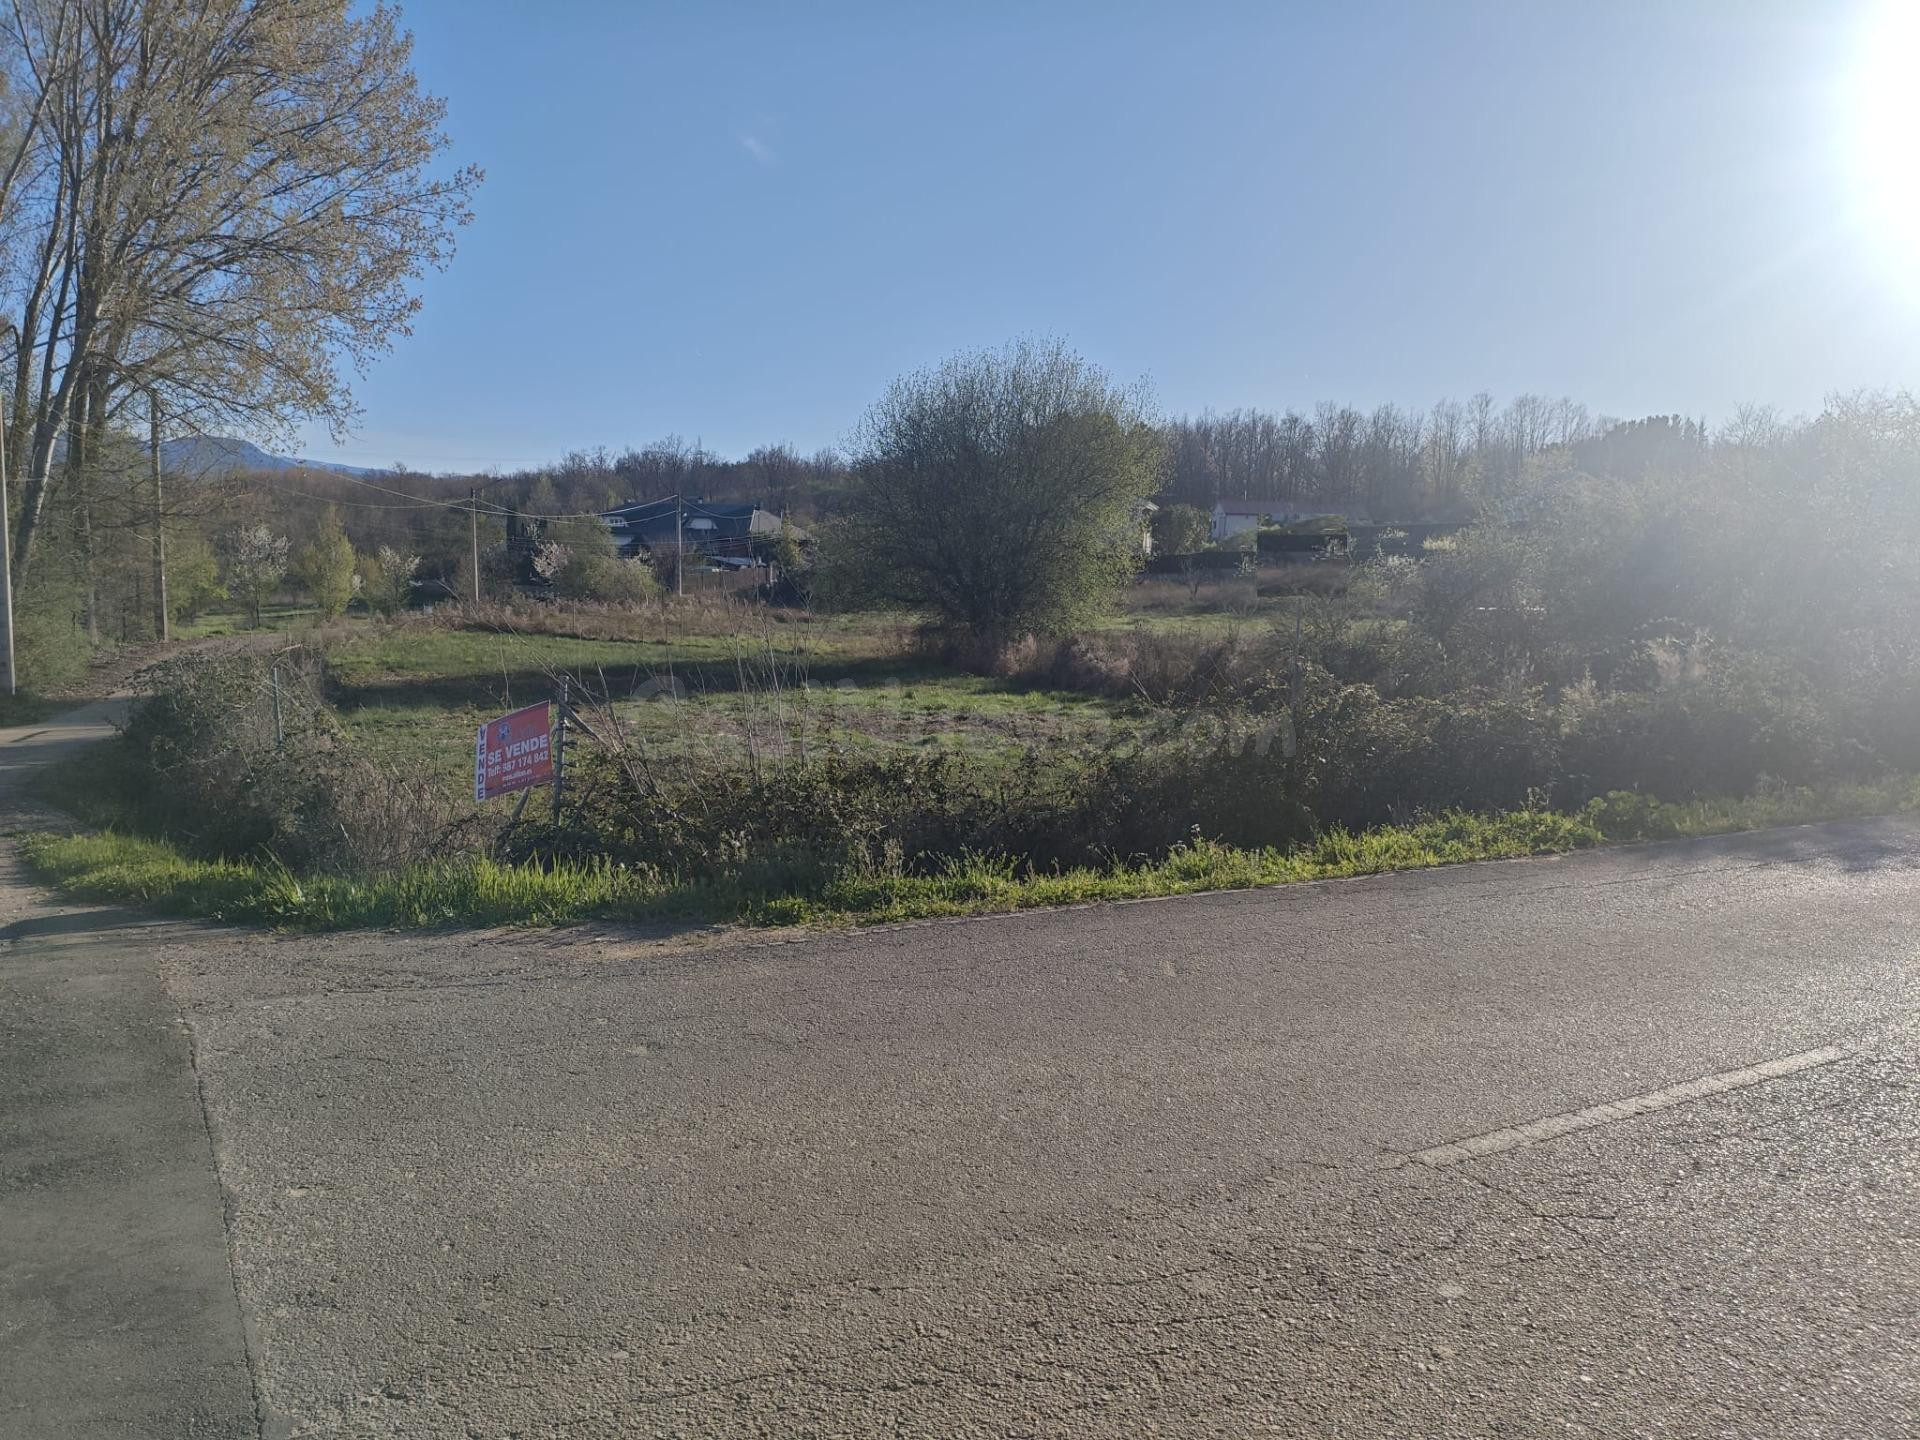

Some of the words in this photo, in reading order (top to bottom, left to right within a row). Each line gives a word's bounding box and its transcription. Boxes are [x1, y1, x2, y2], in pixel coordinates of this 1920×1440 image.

[478, 725, 486, 800] VENDE
[487, 748, 502, 765] SE
[506, 734, 548, 758] VENDE
[518, 755, 532, 768] 174
[534, 751, 549, 763] 842
